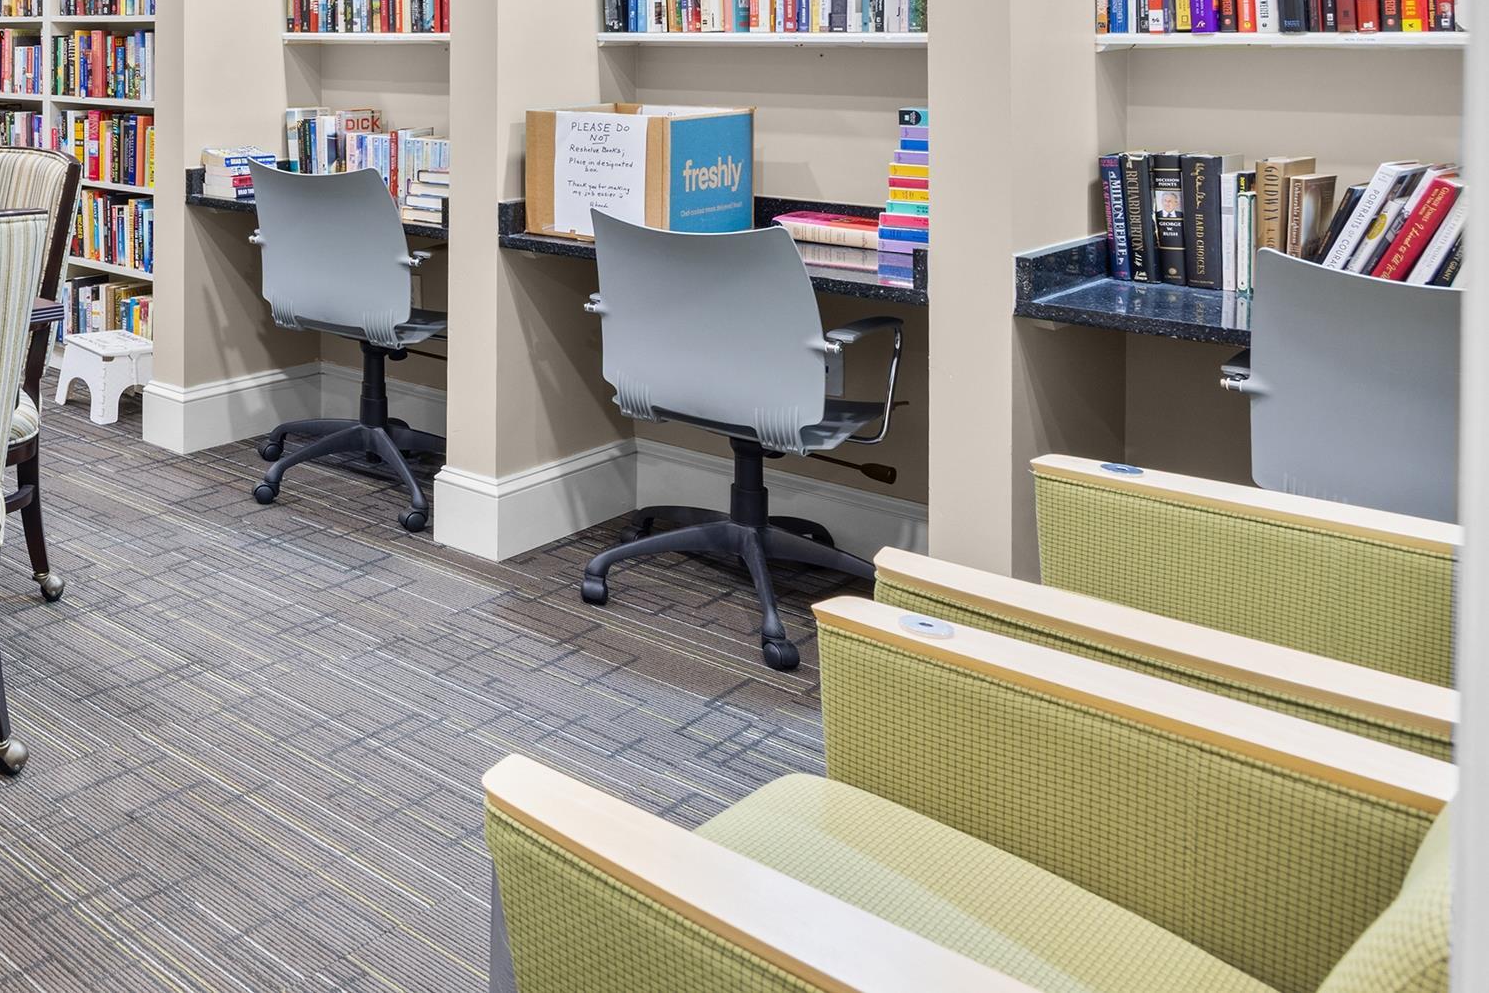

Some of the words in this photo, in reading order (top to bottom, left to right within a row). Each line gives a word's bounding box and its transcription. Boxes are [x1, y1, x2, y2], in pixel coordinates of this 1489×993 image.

[345, 117, 381, 130] DICK
[571, 121, 612, 133] PLEASE
[616, 123, 630, 132] DO
[569, 143, 600, 153] Reshelve
[589, 134, 610, 142] NOT
[596, 162, 634, 170] designated
[683, 155, 743, 192] freshly
[608, 185, 630, 195] making
[1110, 180, 1123, 219] MILTON
[1126, 170, 1139, 213] RICHARD
[1262, 166, 1279, 222] GOLDWYN
[1352, 189, 1380, 230] PORTRAITS
[1130, 214, 1144, 252] BURTON
[1195, 214, 1204, 238] HARD
[1196, 239, 1205, 275] CHOICES
[1442, 261, 1457, 282] GRANT
